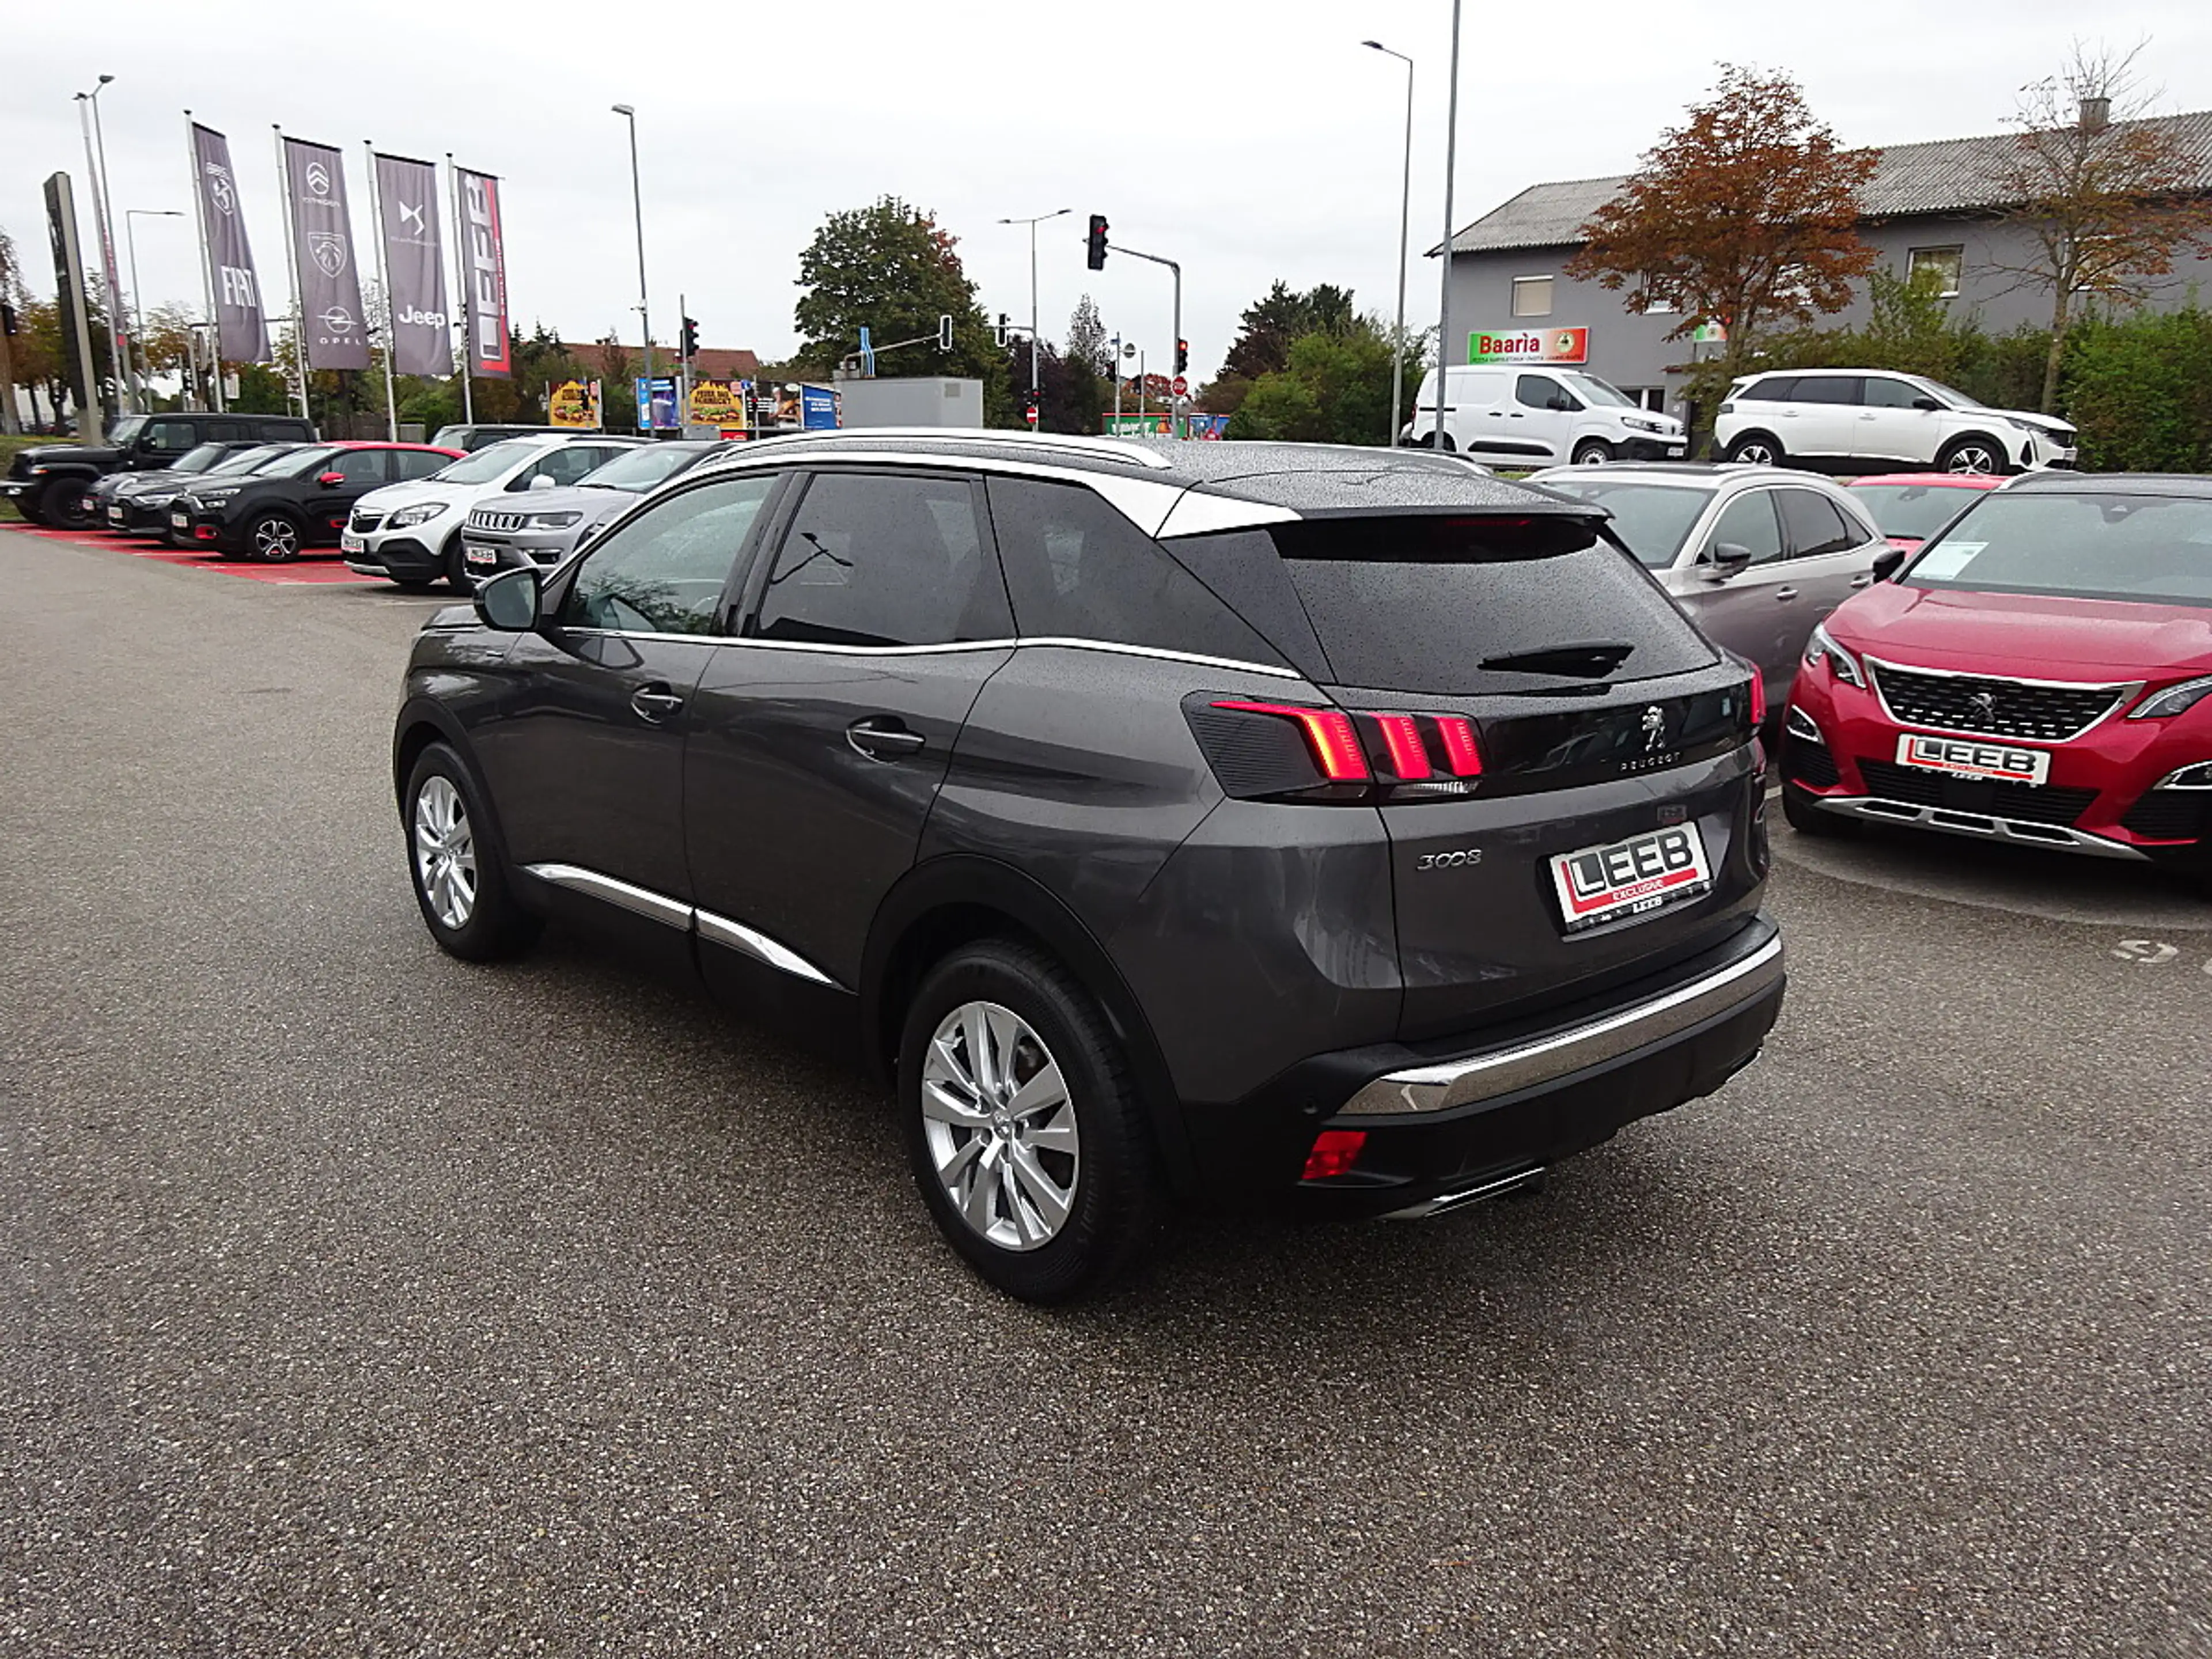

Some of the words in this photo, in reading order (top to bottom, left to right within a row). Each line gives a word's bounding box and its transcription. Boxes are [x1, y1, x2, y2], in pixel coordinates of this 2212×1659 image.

[221, 265, 257, 307] FIAT
[398, 305, 445, 329] Jeep
[319, 337, 361, 345] OPEL
[1479, 332, 1540, 354] Baarìa
[1620, 752, 1680, 771] PEUGEOT
[1915, 739, 2036, 772] LEEB
[1416, 849, 1482, 870] 3008
[1569, 830, 1693, 897] LEEB
[1612, 879, 1664, 900] EXCLUSIVE
